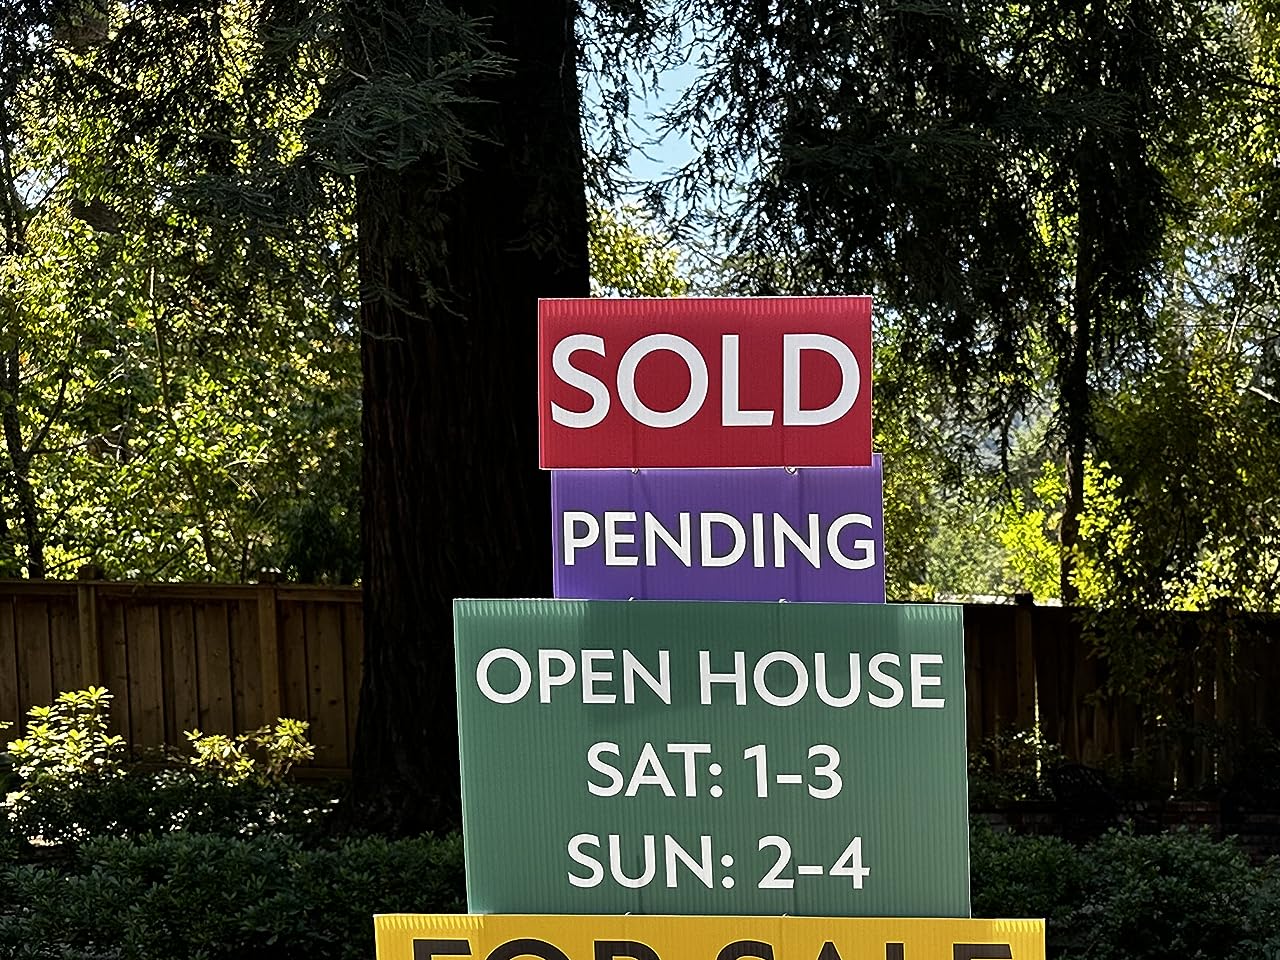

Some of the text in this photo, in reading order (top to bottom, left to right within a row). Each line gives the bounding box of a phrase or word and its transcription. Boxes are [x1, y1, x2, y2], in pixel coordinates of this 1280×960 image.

[549, 333, 862, 428] SOLD
[562, 512, 876, 568] PENDING
[476, 648, 947, 708] OPEN HOUSE
[585, 743, 844, 797] SAT: 1-3
[567, 835, 871, 889] SUN: 2-4
